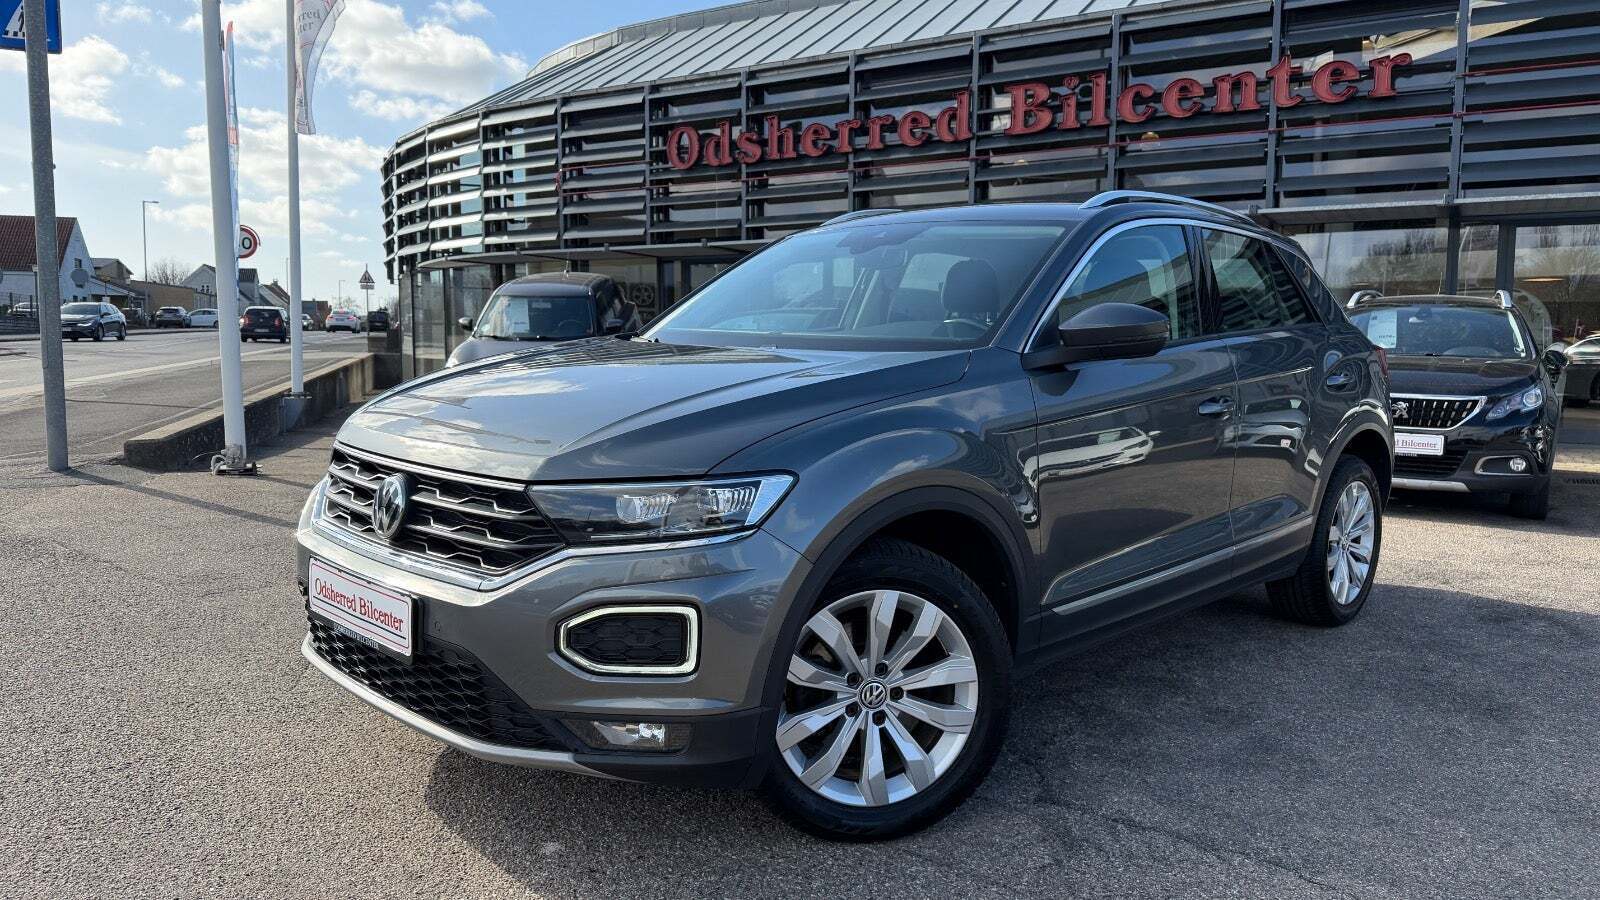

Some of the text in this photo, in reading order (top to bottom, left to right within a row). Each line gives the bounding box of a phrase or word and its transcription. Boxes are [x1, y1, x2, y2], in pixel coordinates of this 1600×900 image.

[666, 52, 1413, 170] Odsherred Bilcenter
[315, 577, 404, 633] Odsherred Bilcenter
